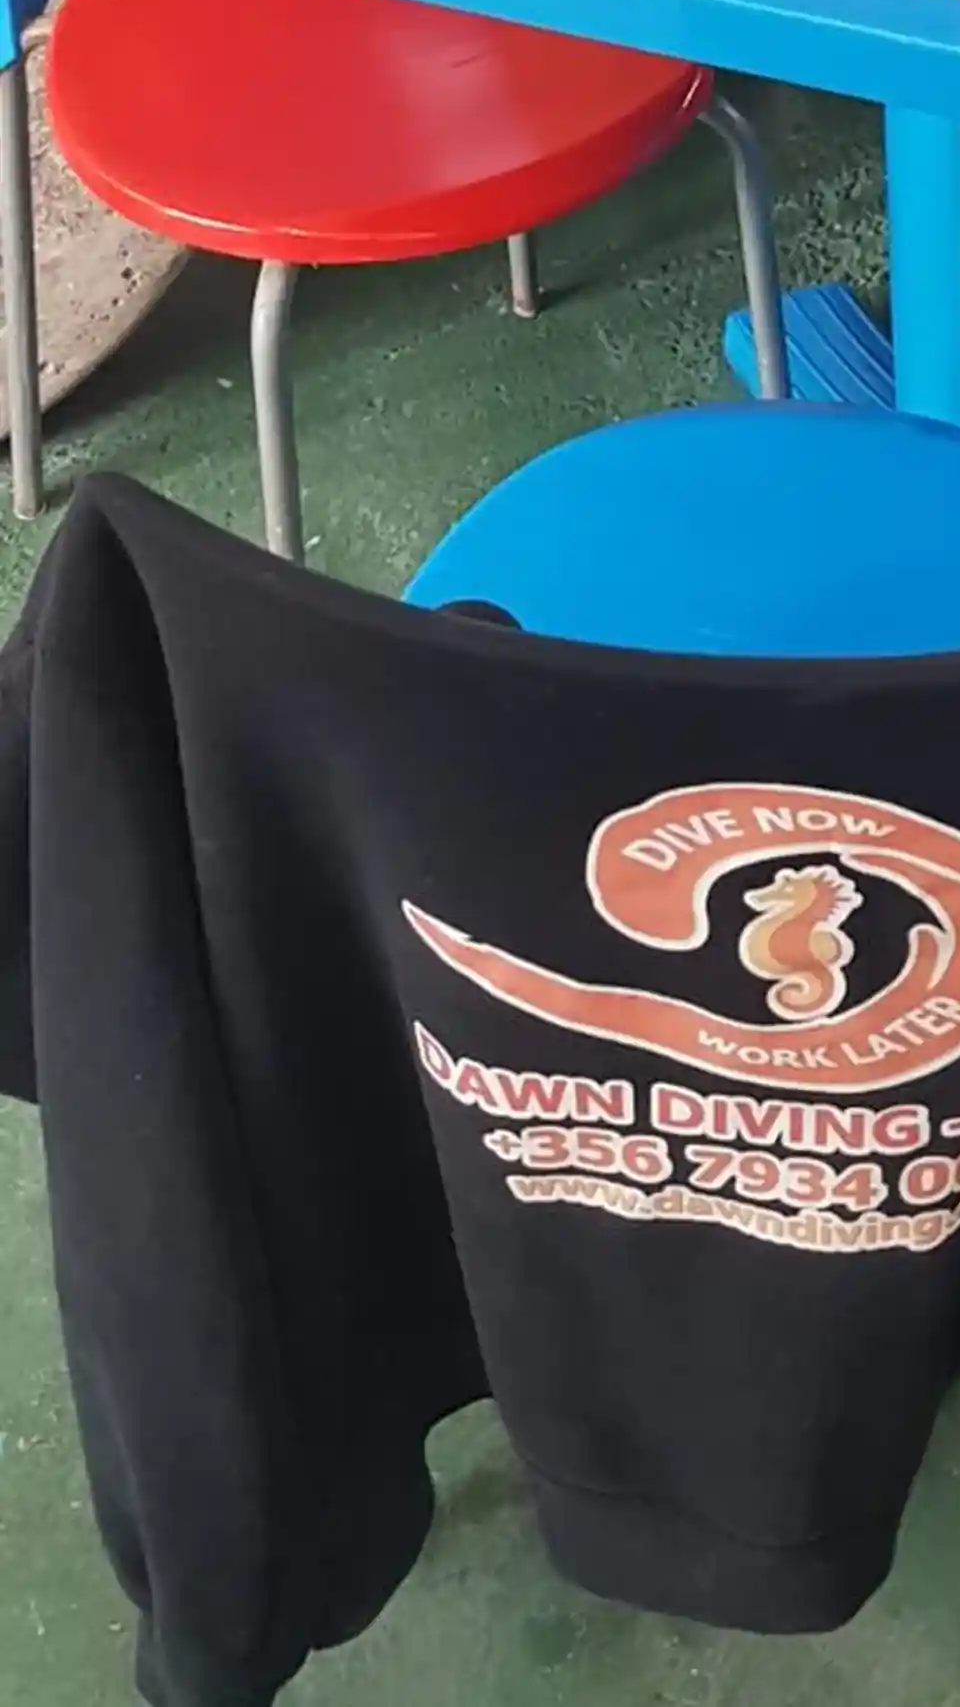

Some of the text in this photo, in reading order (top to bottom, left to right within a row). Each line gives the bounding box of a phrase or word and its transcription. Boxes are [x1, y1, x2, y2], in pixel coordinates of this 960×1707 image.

[622, 806, 896, 871] DIVE NOW
[698, 1029, 838, 1069] WORK
[415, 1021, 634, 1125] DAWN
[650, 1082, 930, 1155] DIVING
[483, 1126, 672, 1183] +356
[684, 1144, 889, 1211] 7934
